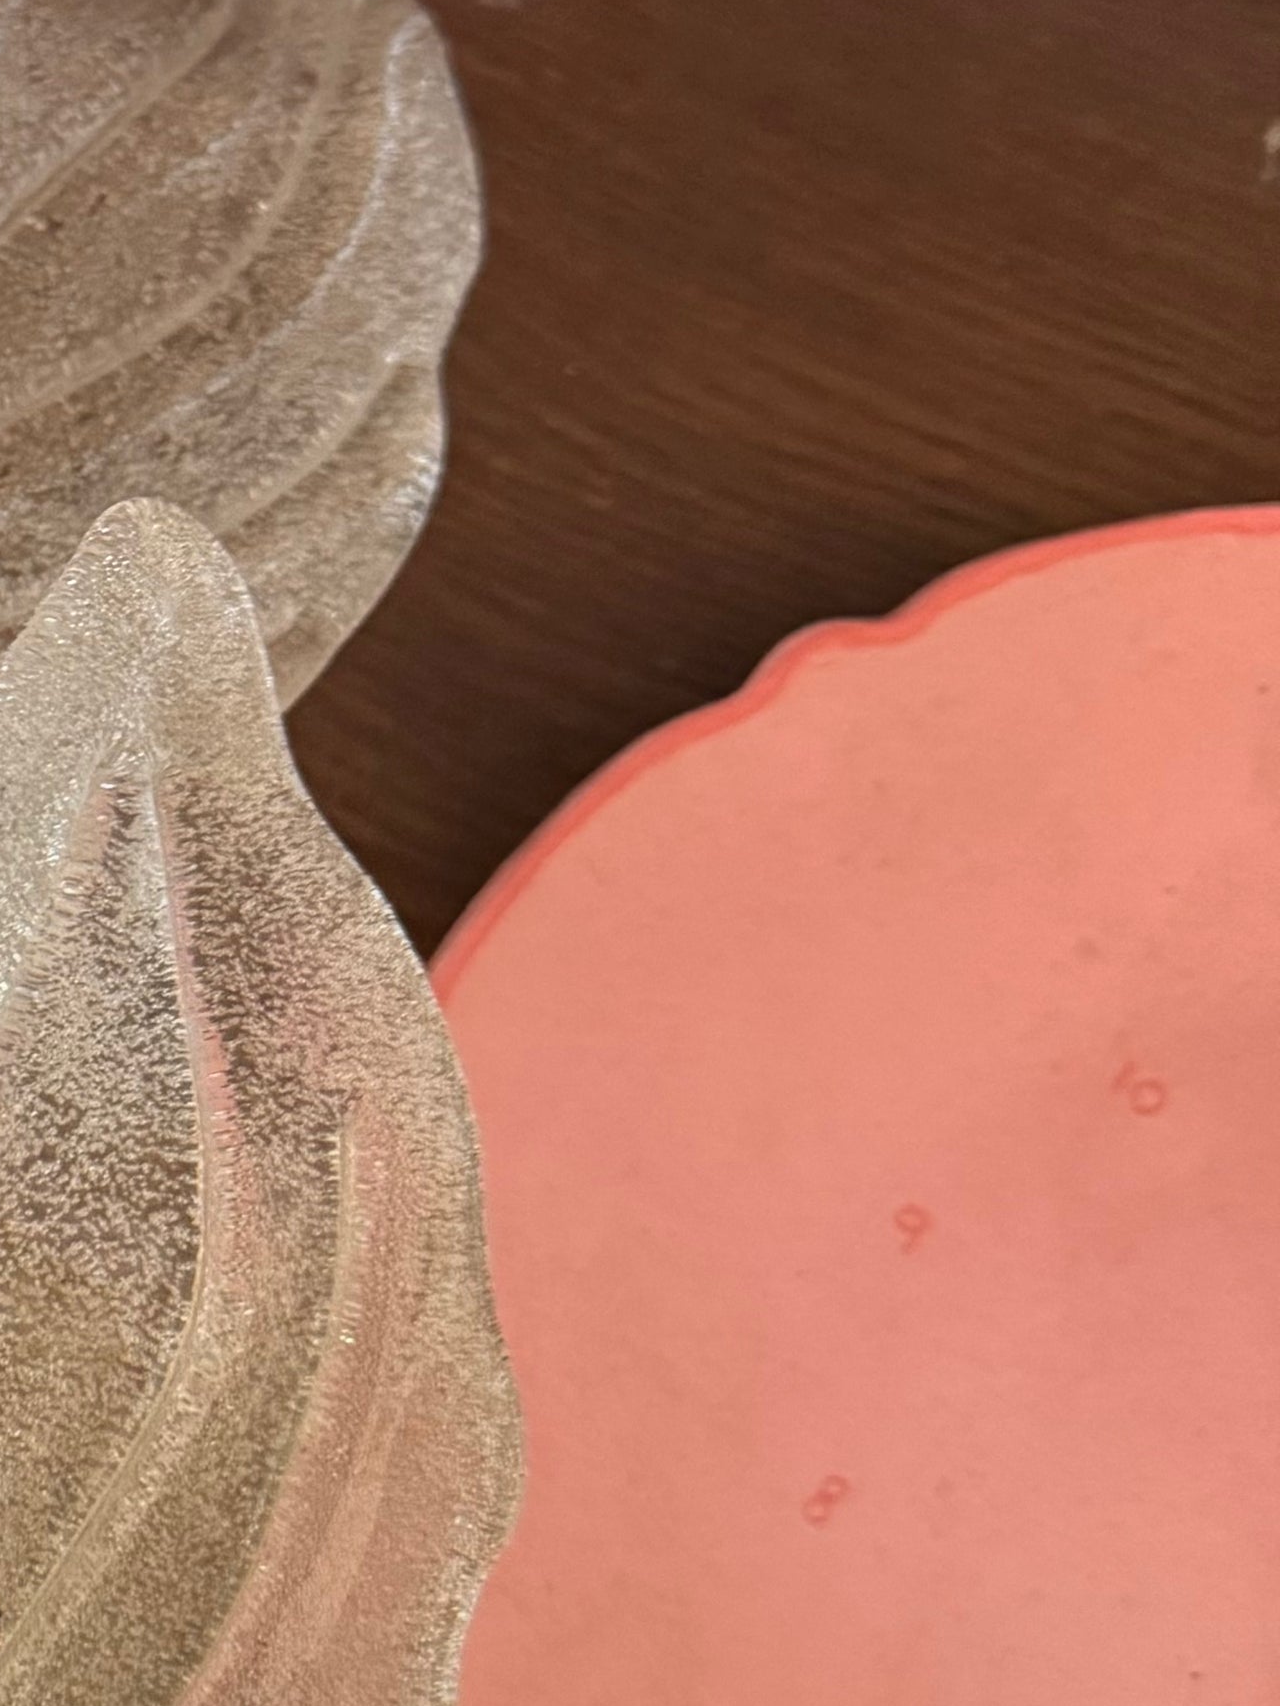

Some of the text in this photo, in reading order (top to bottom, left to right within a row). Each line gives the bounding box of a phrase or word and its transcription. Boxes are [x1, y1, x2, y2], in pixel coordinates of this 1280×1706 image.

[1110, 1060, 1170, 1116] 10
[893, 1202, 933, 1255] 9
[801, 1475, 849, 1530] 8
